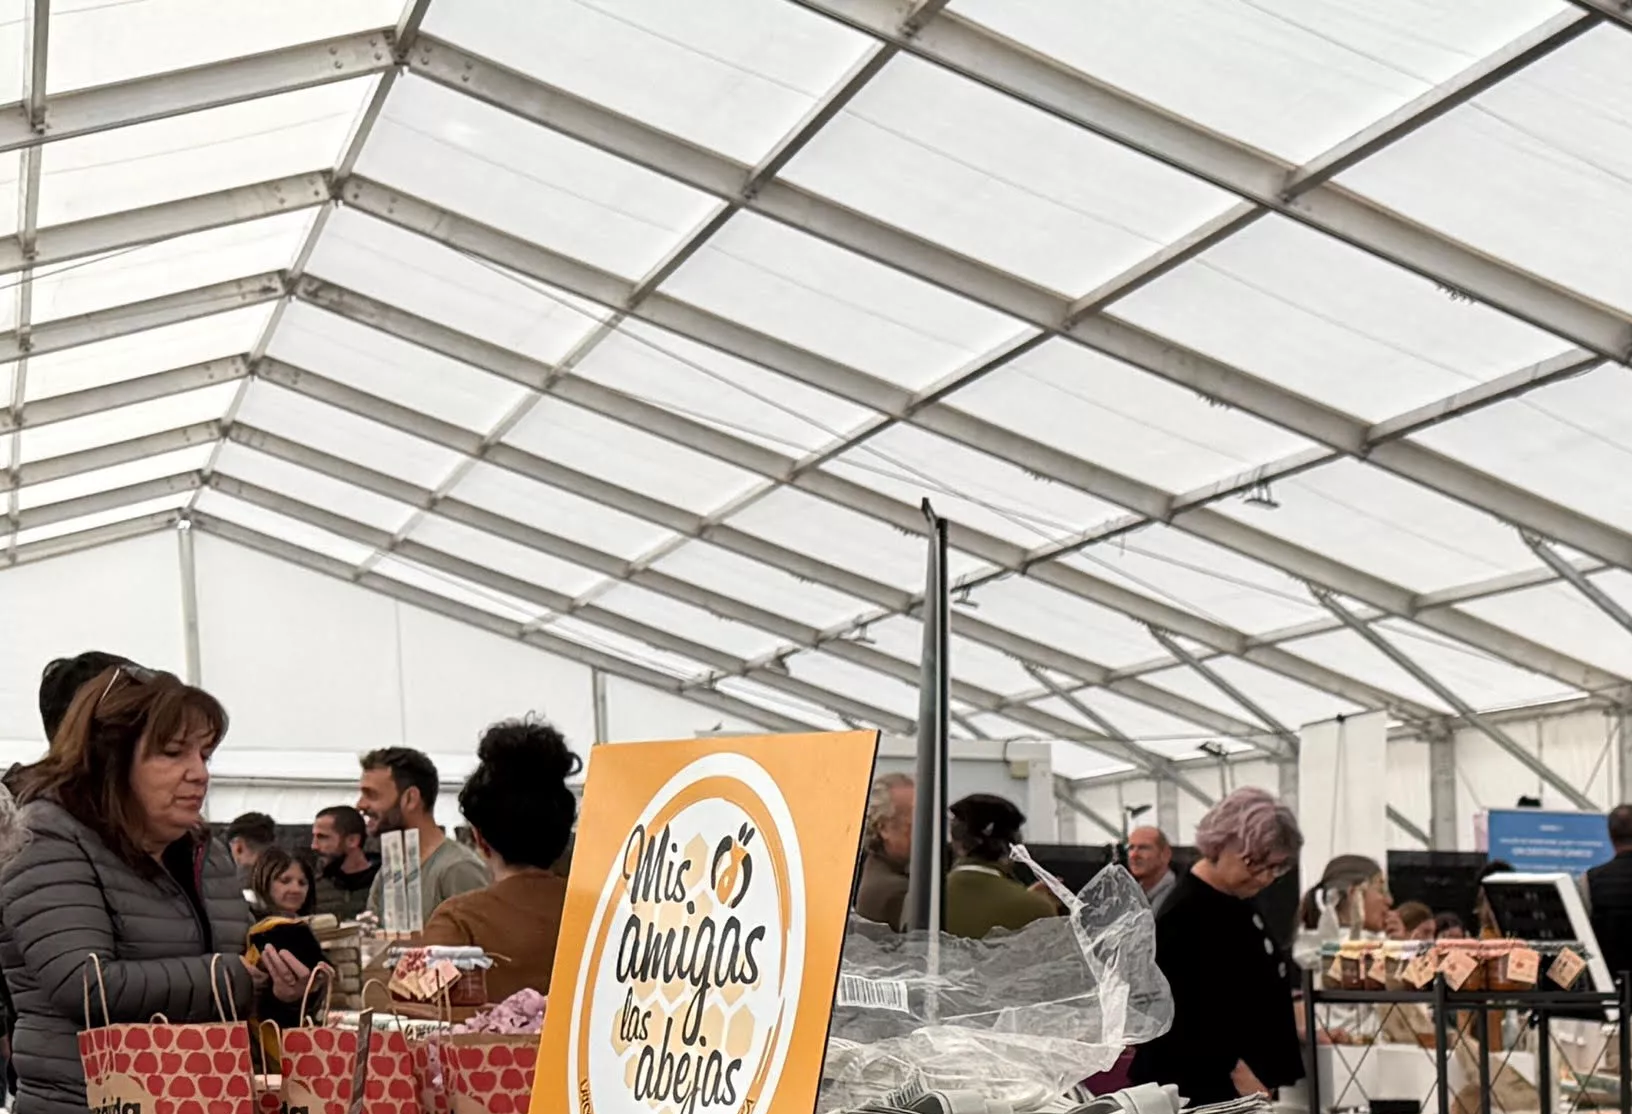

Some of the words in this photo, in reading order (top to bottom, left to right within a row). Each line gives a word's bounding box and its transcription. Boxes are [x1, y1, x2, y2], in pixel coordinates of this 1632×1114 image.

[623, 822, 690, 904] Mis
[616, 900, 766, 1046] amigas
[619, 986, 652, 1042] las
